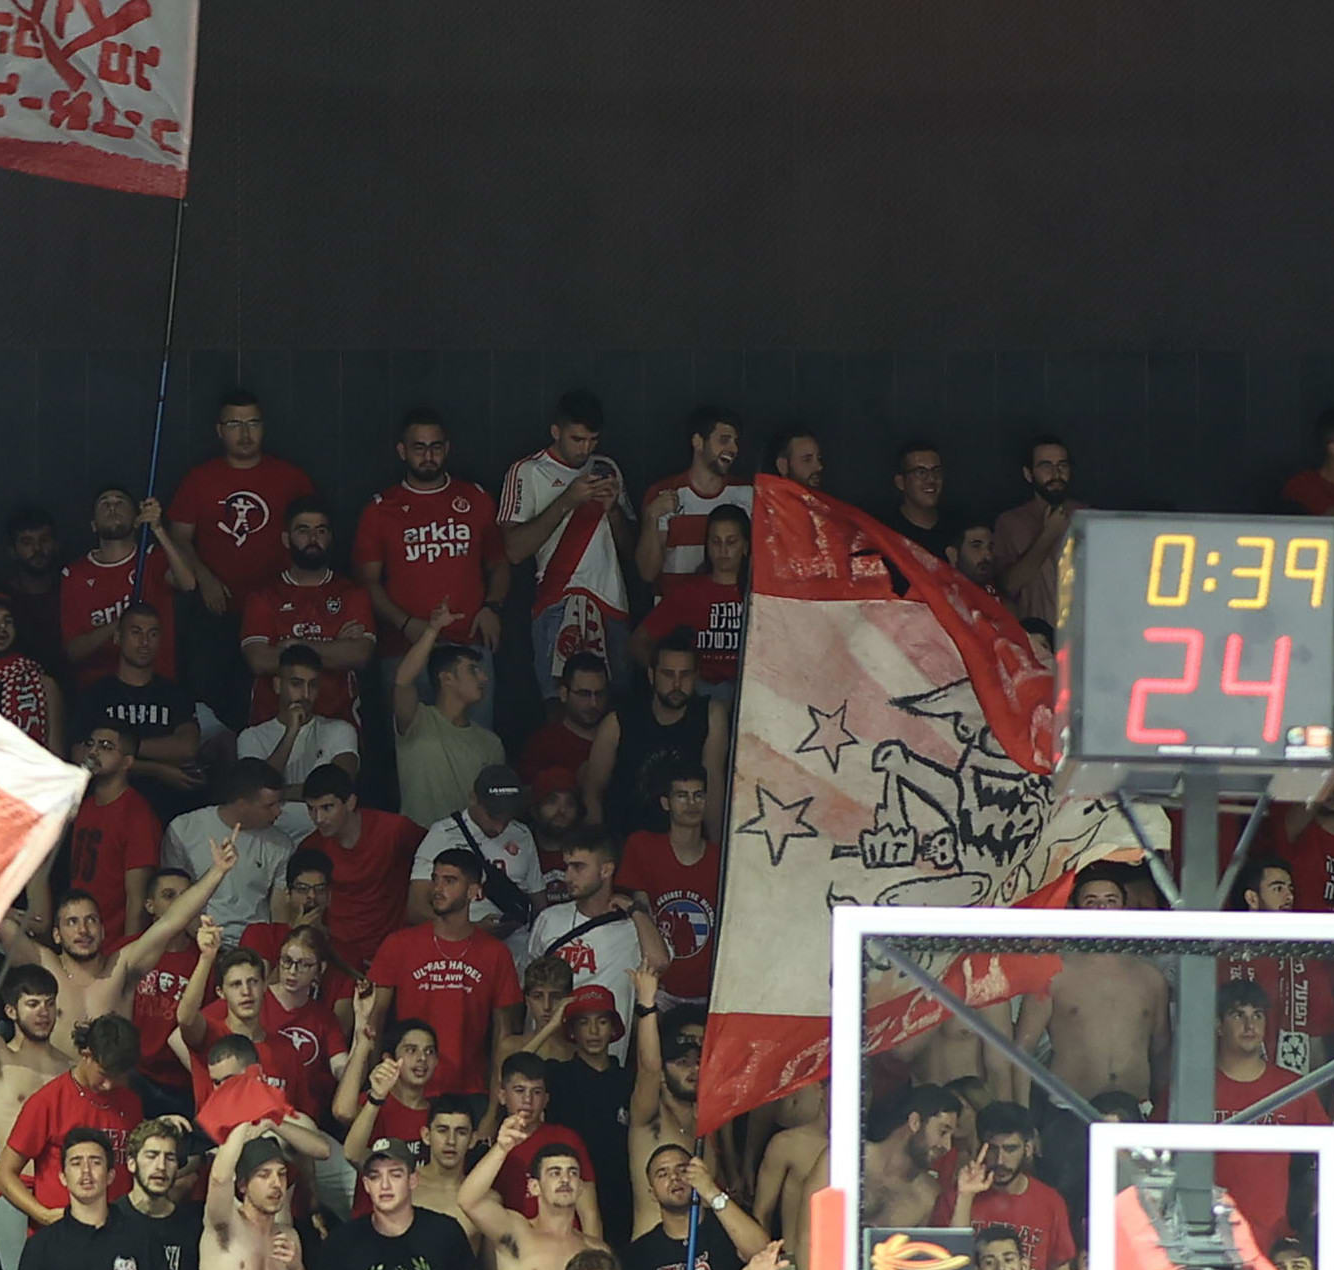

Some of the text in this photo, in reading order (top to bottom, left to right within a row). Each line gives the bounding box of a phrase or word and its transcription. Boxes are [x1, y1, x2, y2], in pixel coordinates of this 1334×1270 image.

[403, 518, 470, 543] arkia
[405, 543, 469, 563] ארקיע
[1147, 535, 1329, 609] 0:39
[1127, 627, 1292, 744] 24
